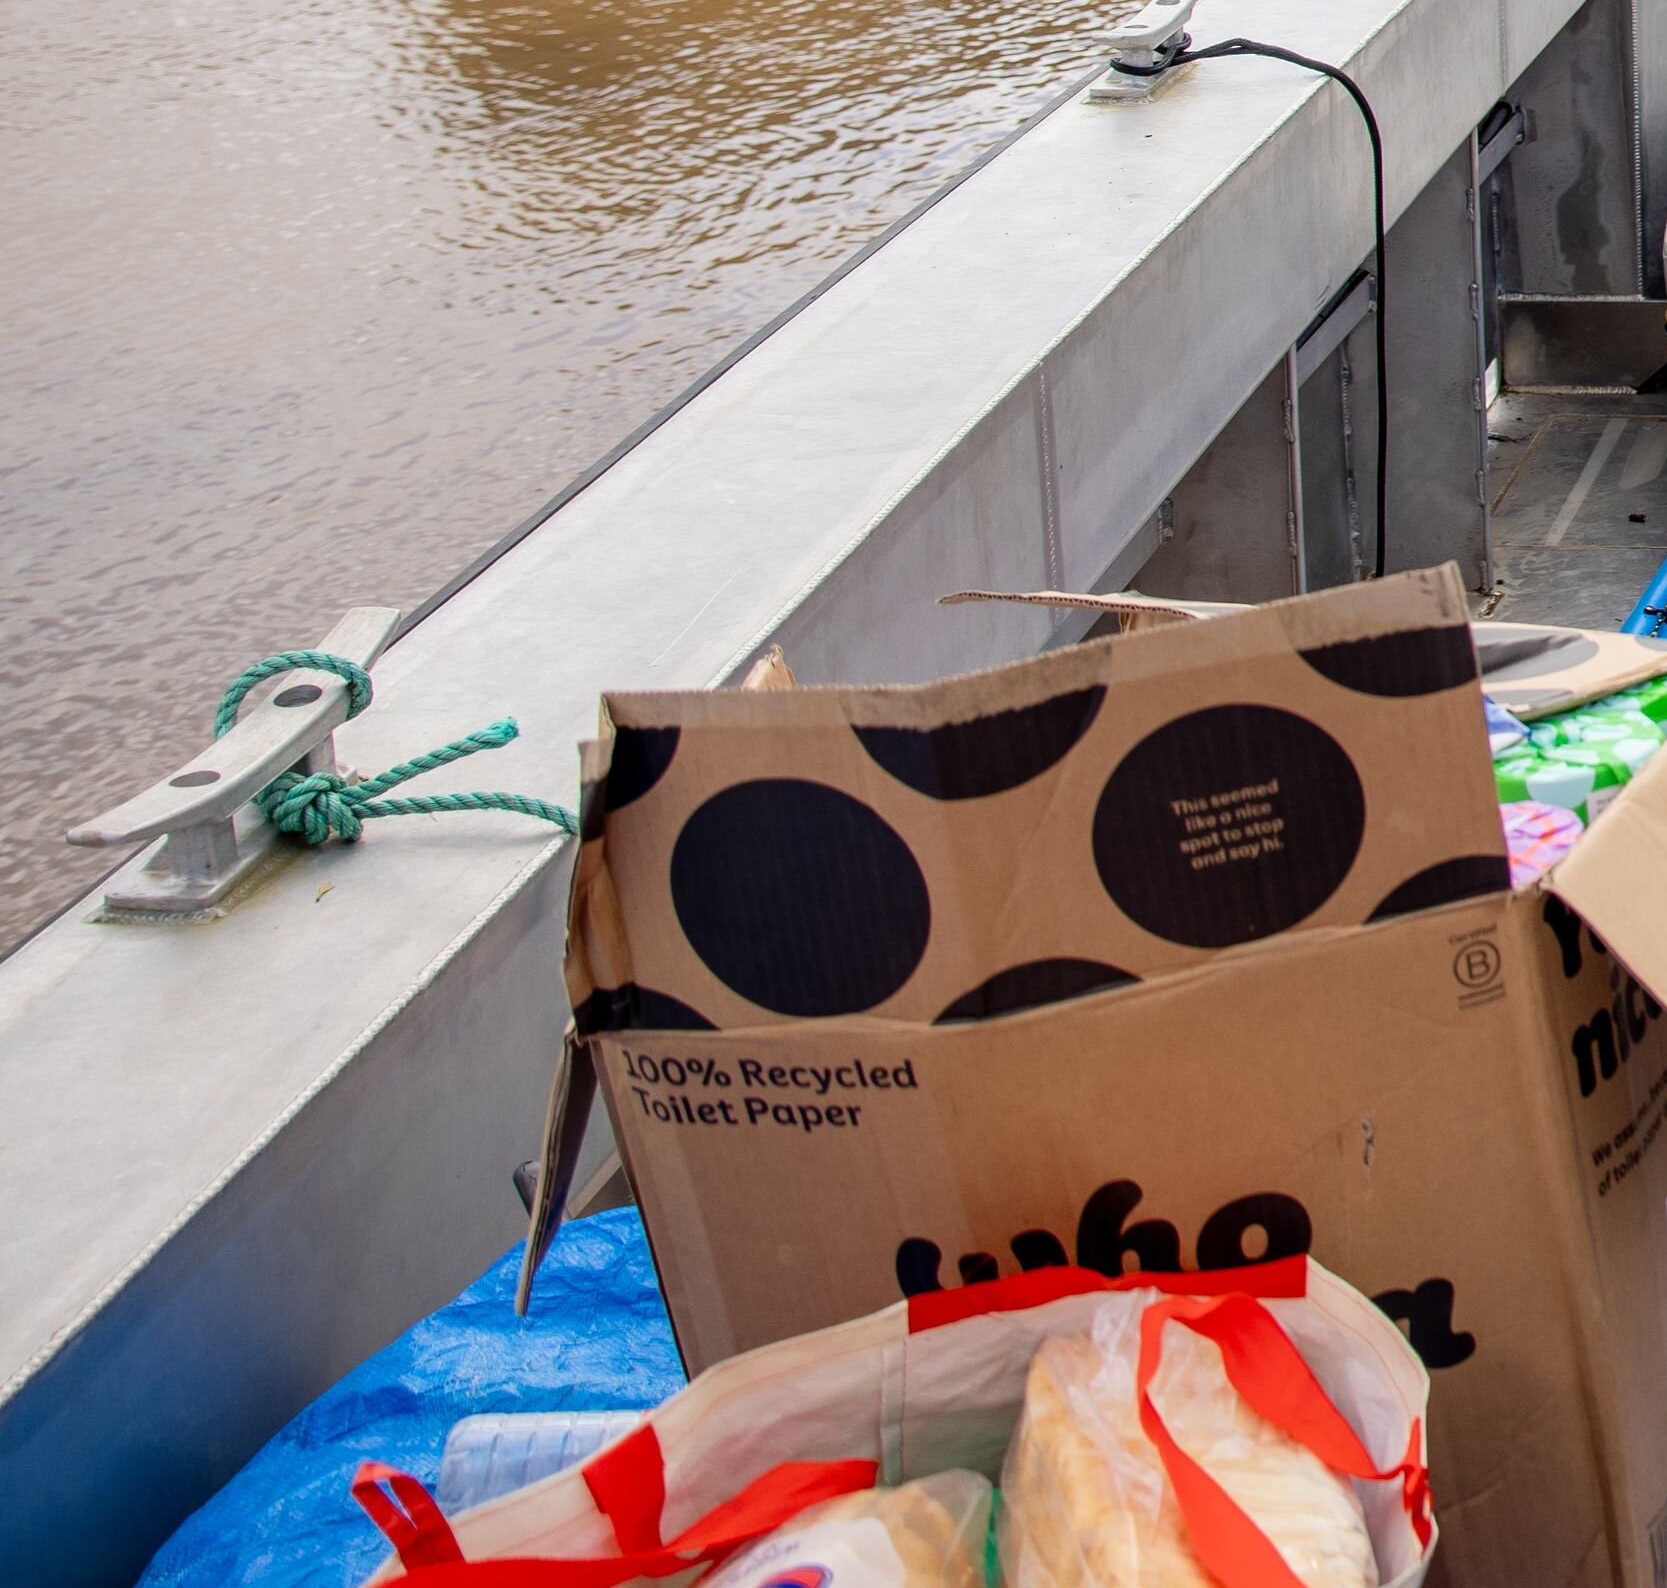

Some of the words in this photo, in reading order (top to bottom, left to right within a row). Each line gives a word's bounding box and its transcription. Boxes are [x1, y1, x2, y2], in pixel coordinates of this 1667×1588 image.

[1170, 798, 1208, 817] This
[1210, 778, 1279, 808] seemed
[1185, 814, 1217, 833] like
[1219, 811, 1232, 825] a
[1235, 802, 1272, 820] nice
[1180, 832, 1219, 855] spot
[1223, 828, 1242, 842] to
[1244, 818, 1285, 838] stop
[1191, 847, 1226, 870] and
[1229, 842, 1260, 861] say
[1466, 949, 1491, 980] B
[622, 1050, 731, 1087] 100%
[739, 1058, 918, 1096] Recycled
[631, 1085, 739, 1125] Toilet
[744, 1096, 862, 1133] Paper
